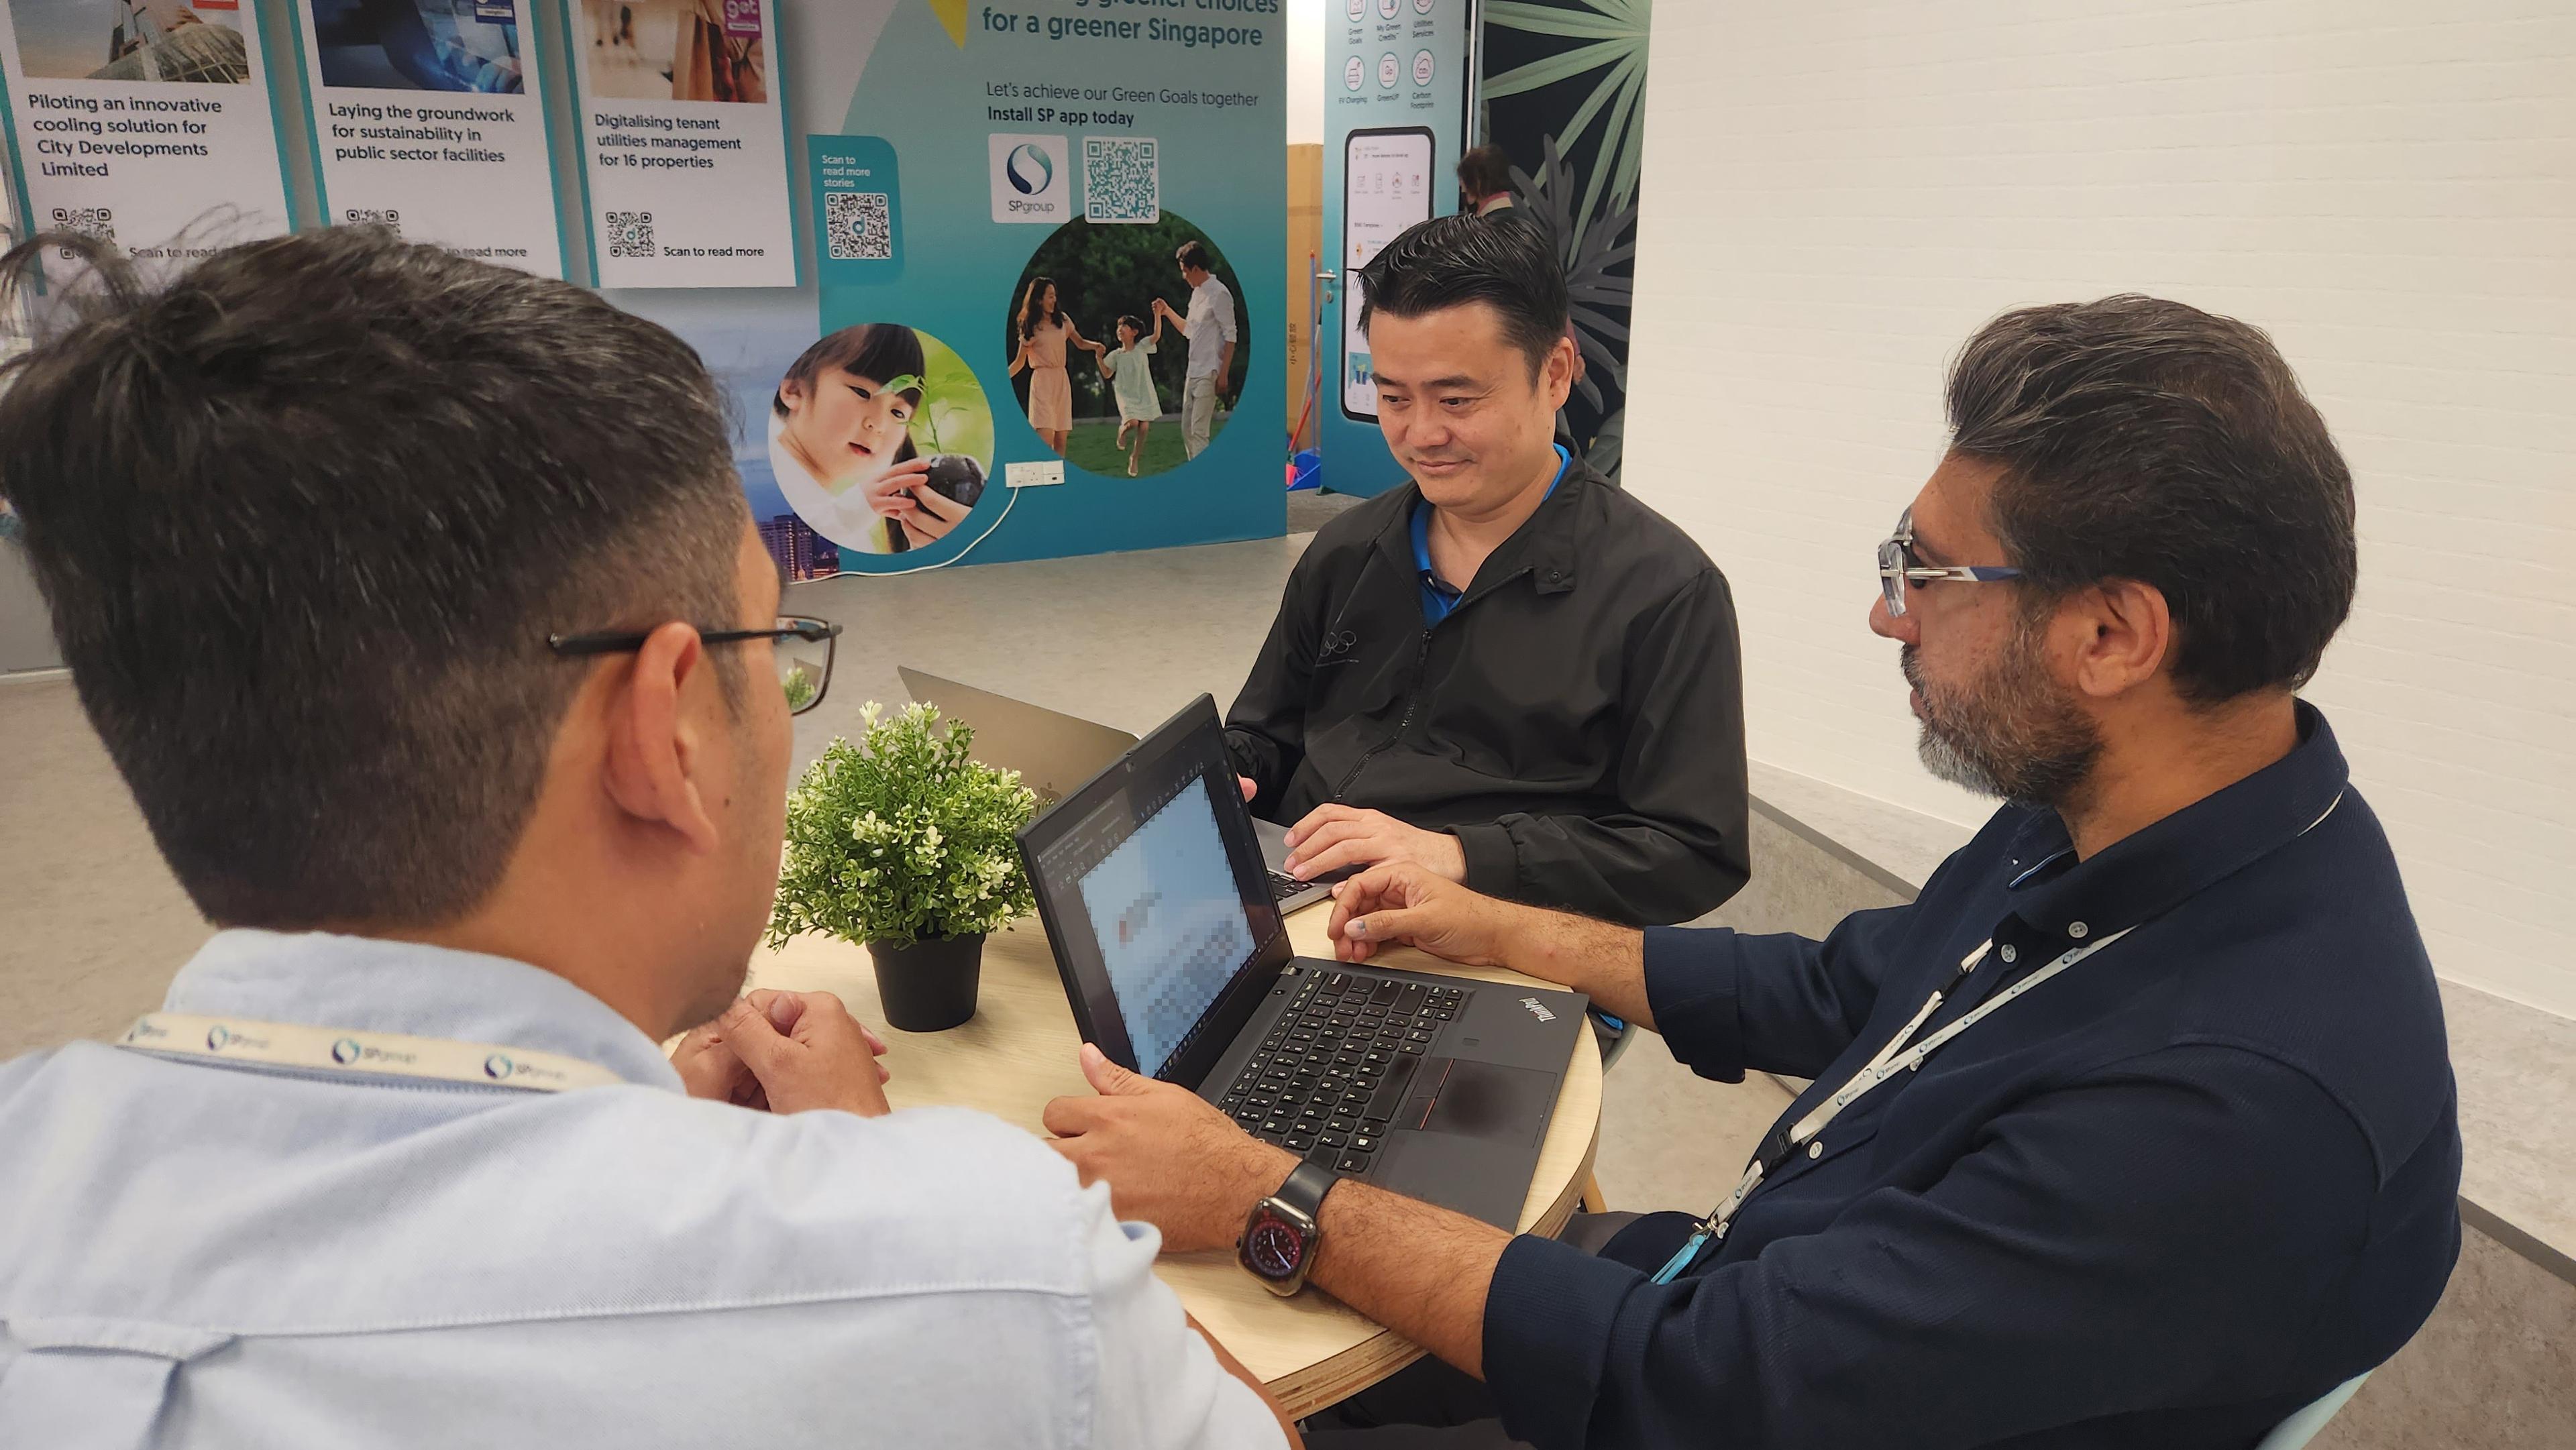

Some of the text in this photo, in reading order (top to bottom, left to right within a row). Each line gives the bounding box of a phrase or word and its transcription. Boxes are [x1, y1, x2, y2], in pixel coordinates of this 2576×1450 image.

[983, 7, 1263, 48] for a greener Singapore
[987, 81, 1258, 108] Let's achieve our Green Goals together
[29, 94, 222, 113] Piloting an innovative
[329, 103, 515, 122] Laying the groundwork
[988, 106, 1134, 127] Install SP app today
[34, 117, 207, 135] cooling solution for
[595, 113, 720, 131] Digitalising tenant
[332, 124, 482, 144] for sustainability in
[597, 133, 742, 152] utilities management
[38, 140, 208, 158] City Developments
[336, 146, 505, 162] public sector facilities
[599, 153, 714, 169] for 16 properties
[822, 155, 856, 164] Scan to
[42, 162, 109, 176] Limited
[823, 166, 871, 176] read more
[824, 178, 855, 187] stories
[1009, 200, 1055, 214] SPgroup
[129, 247, 164, 258] Scan
[167, 247, 182, 258] to
[464, 246, 492, 257] read
[495, 247, 527, 257] more
[663, 247, 764, 257] Scan to read more
